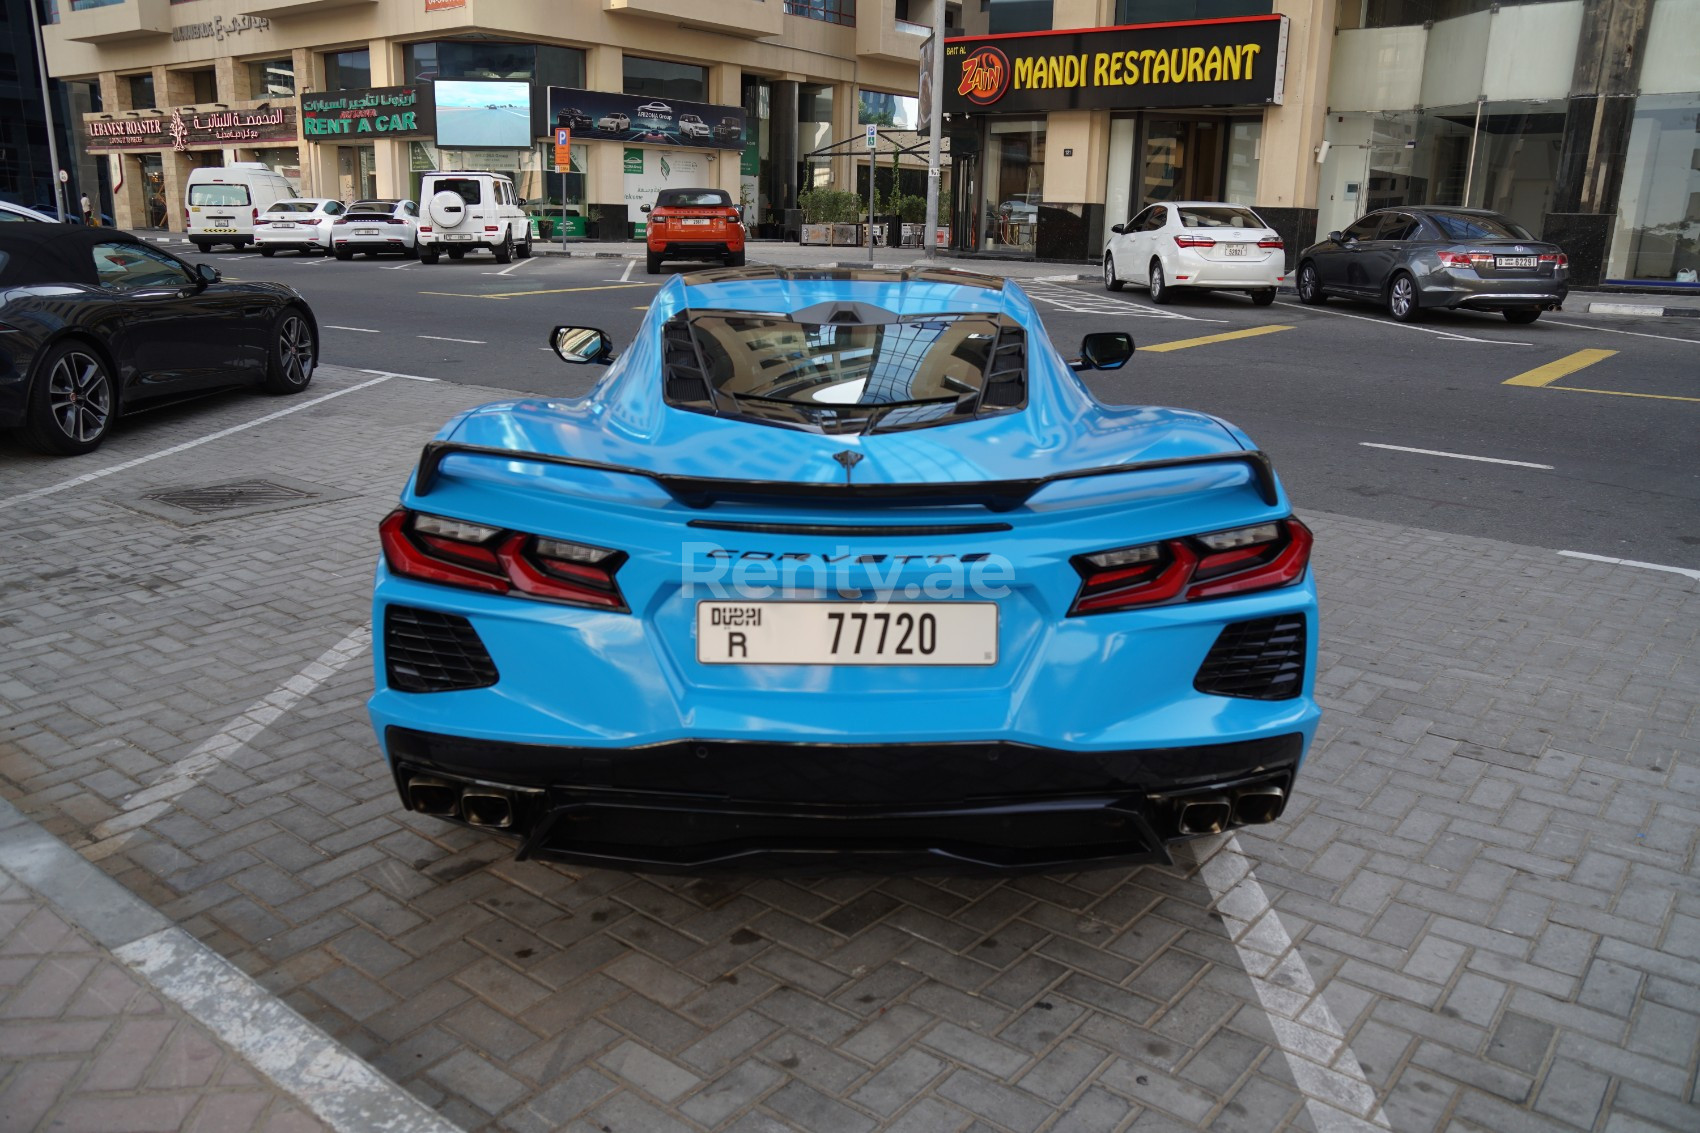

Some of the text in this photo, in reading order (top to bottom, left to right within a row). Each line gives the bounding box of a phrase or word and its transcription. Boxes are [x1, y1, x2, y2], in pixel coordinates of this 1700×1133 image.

[946, 46, 966, 56] BAIT AL
[1014, 44, 1261, 89] MANDI RESTAURANT
[90, 119, 161, 136] LEBANESE ROASTER
[193, 109, 283, 131] المحمصة اللبنانية
[304, 111, 418, 134] RENT A CAR
[560, 131, 567, 145] P
[1515, 258, 1536, 267] 62291
[706, 548, 991, 564] CORVETTE
[728, 631, 747, 657] R
[827, 613, 937, 656] 77720
